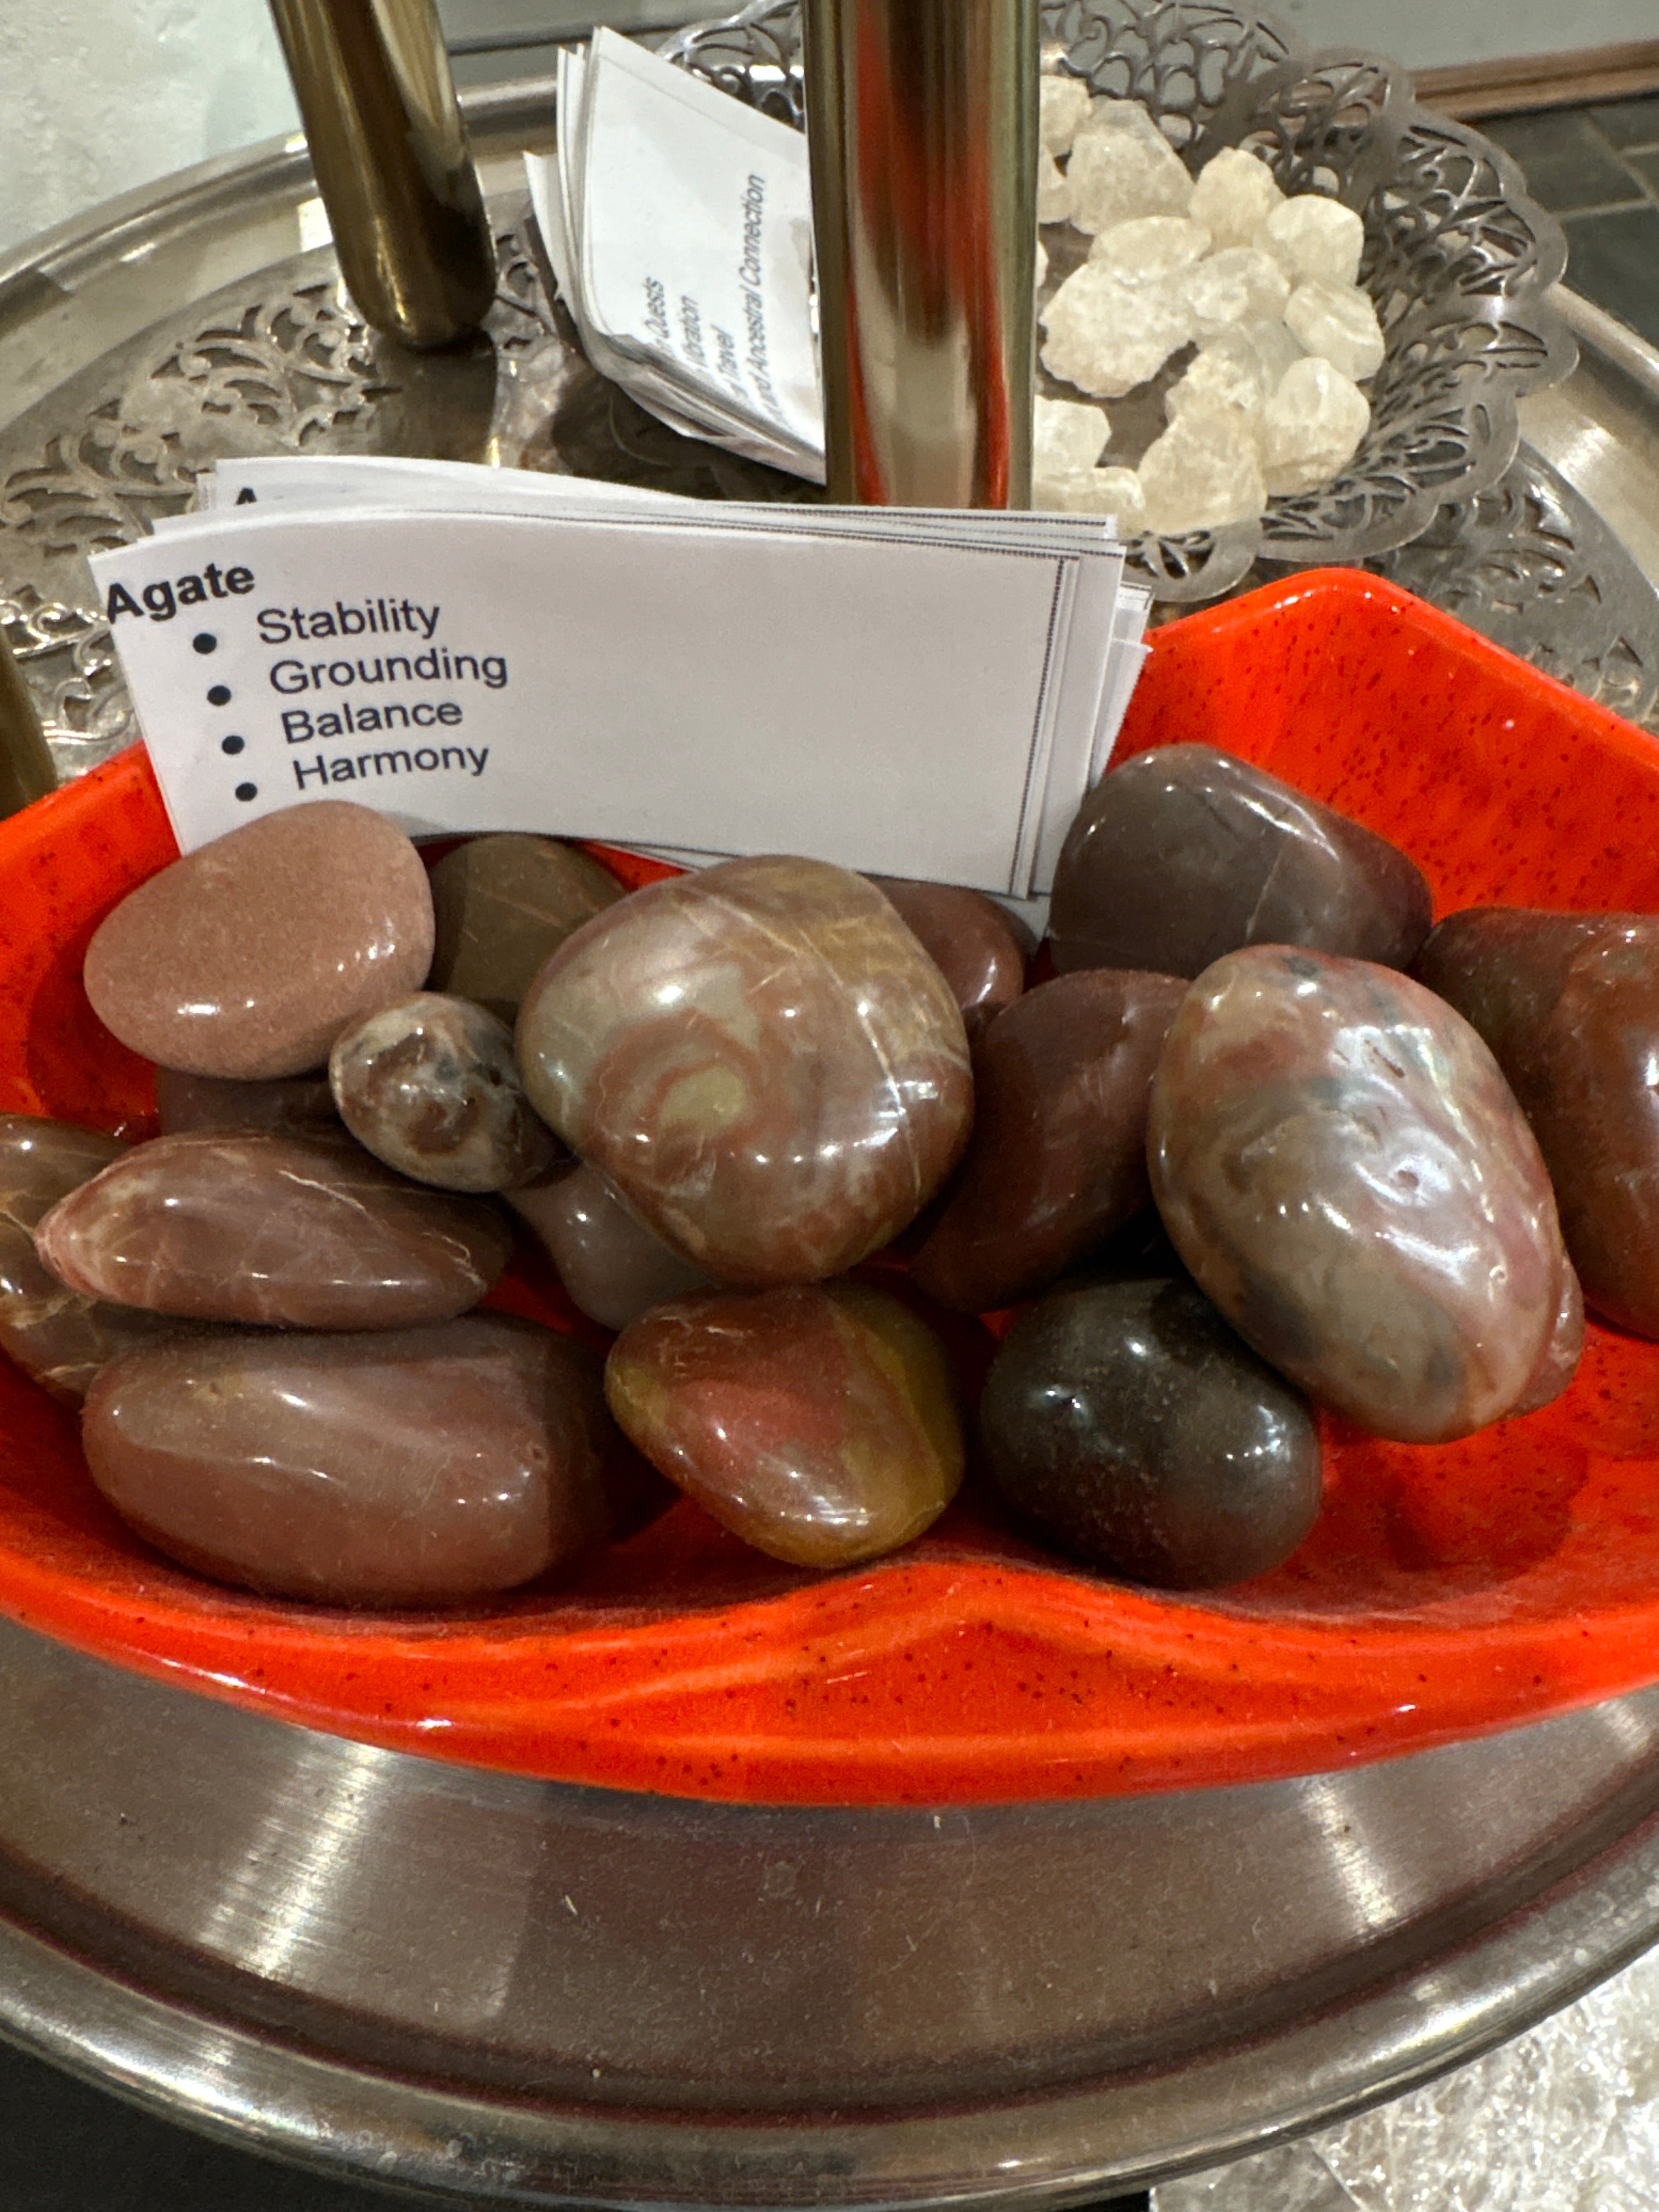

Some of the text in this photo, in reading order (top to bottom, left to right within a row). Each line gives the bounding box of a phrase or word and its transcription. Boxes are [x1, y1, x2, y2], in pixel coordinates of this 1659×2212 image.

[739, 174, 765, 285] Connection
[642, 276, 669, 338] Quests
[739, 284, 769, 377] Ancestral
[710, 324, 741, 381] Travel
[107, 563, 256, 624] Agate
[257, 599, 440, 645] Stability
[270, 648, 507, 695] Grounding
[281, 702, 462, 744] Balance
[294, 745, 489, 790] Harmony
